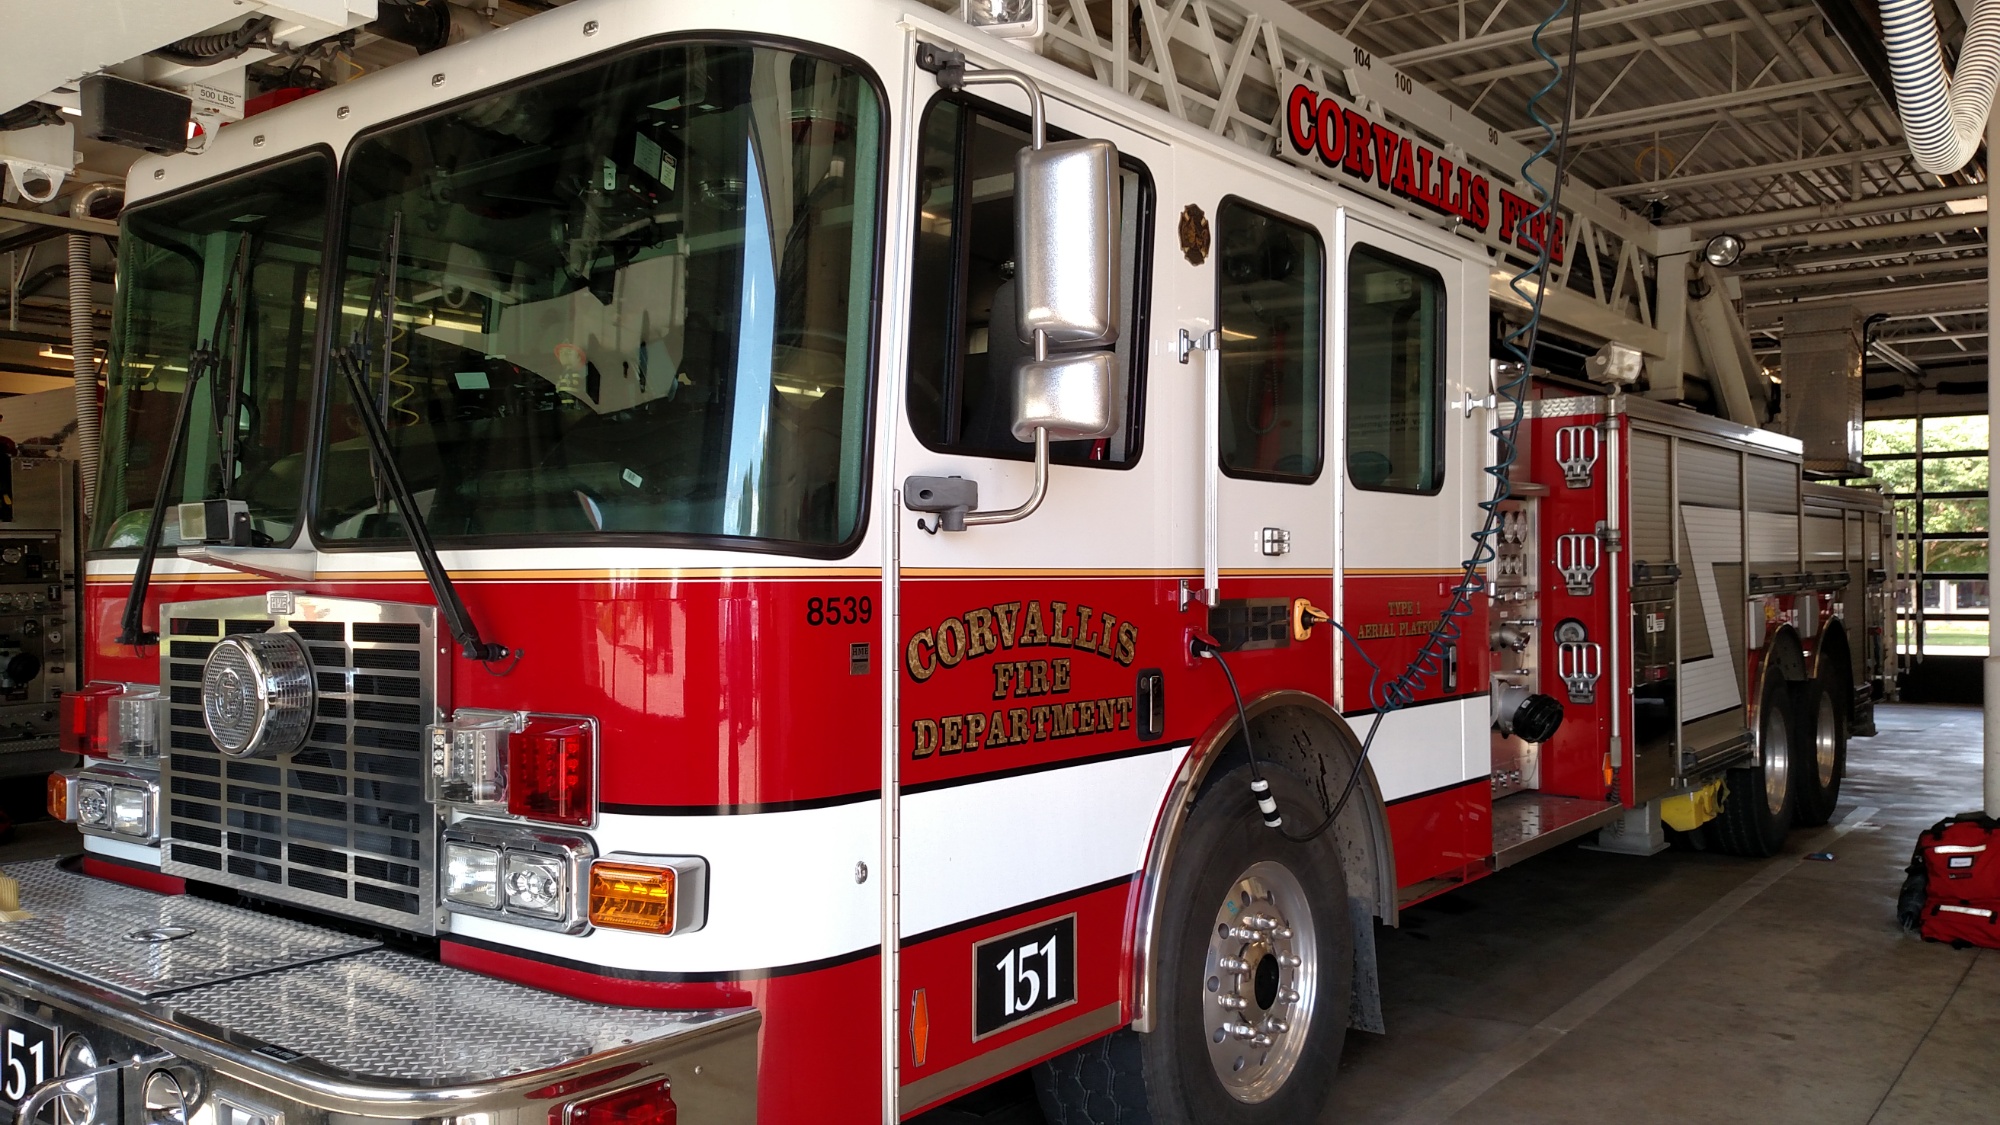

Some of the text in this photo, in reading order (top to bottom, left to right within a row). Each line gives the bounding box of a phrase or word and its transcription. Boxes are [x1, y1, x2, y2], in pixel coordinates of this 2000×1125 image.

[1353, 46, 1371, 71] 104
[200, 89, 216, 100] 500
[217, 94, 235, 105] LBS
[1394, 71, 1412, 95] 100
[1488, 127, 1499, 146] 90
[1287, 84, 1565, 268] CORVALLIS FIRE
[806, 595, 873, 626] 8539
[1388, 601, 1413, 616] TYPE
[906, 600, 1138, 684] CORVALLIS
[1357, 622, 1396, 641] AERIAL
[993, 657, 1072, 699] FIRE
[911, 695, 1134, 760] DEPARTMENT
[996, 934, 1057, 1016] 151
[0, 1028, 45, 1101] 51
